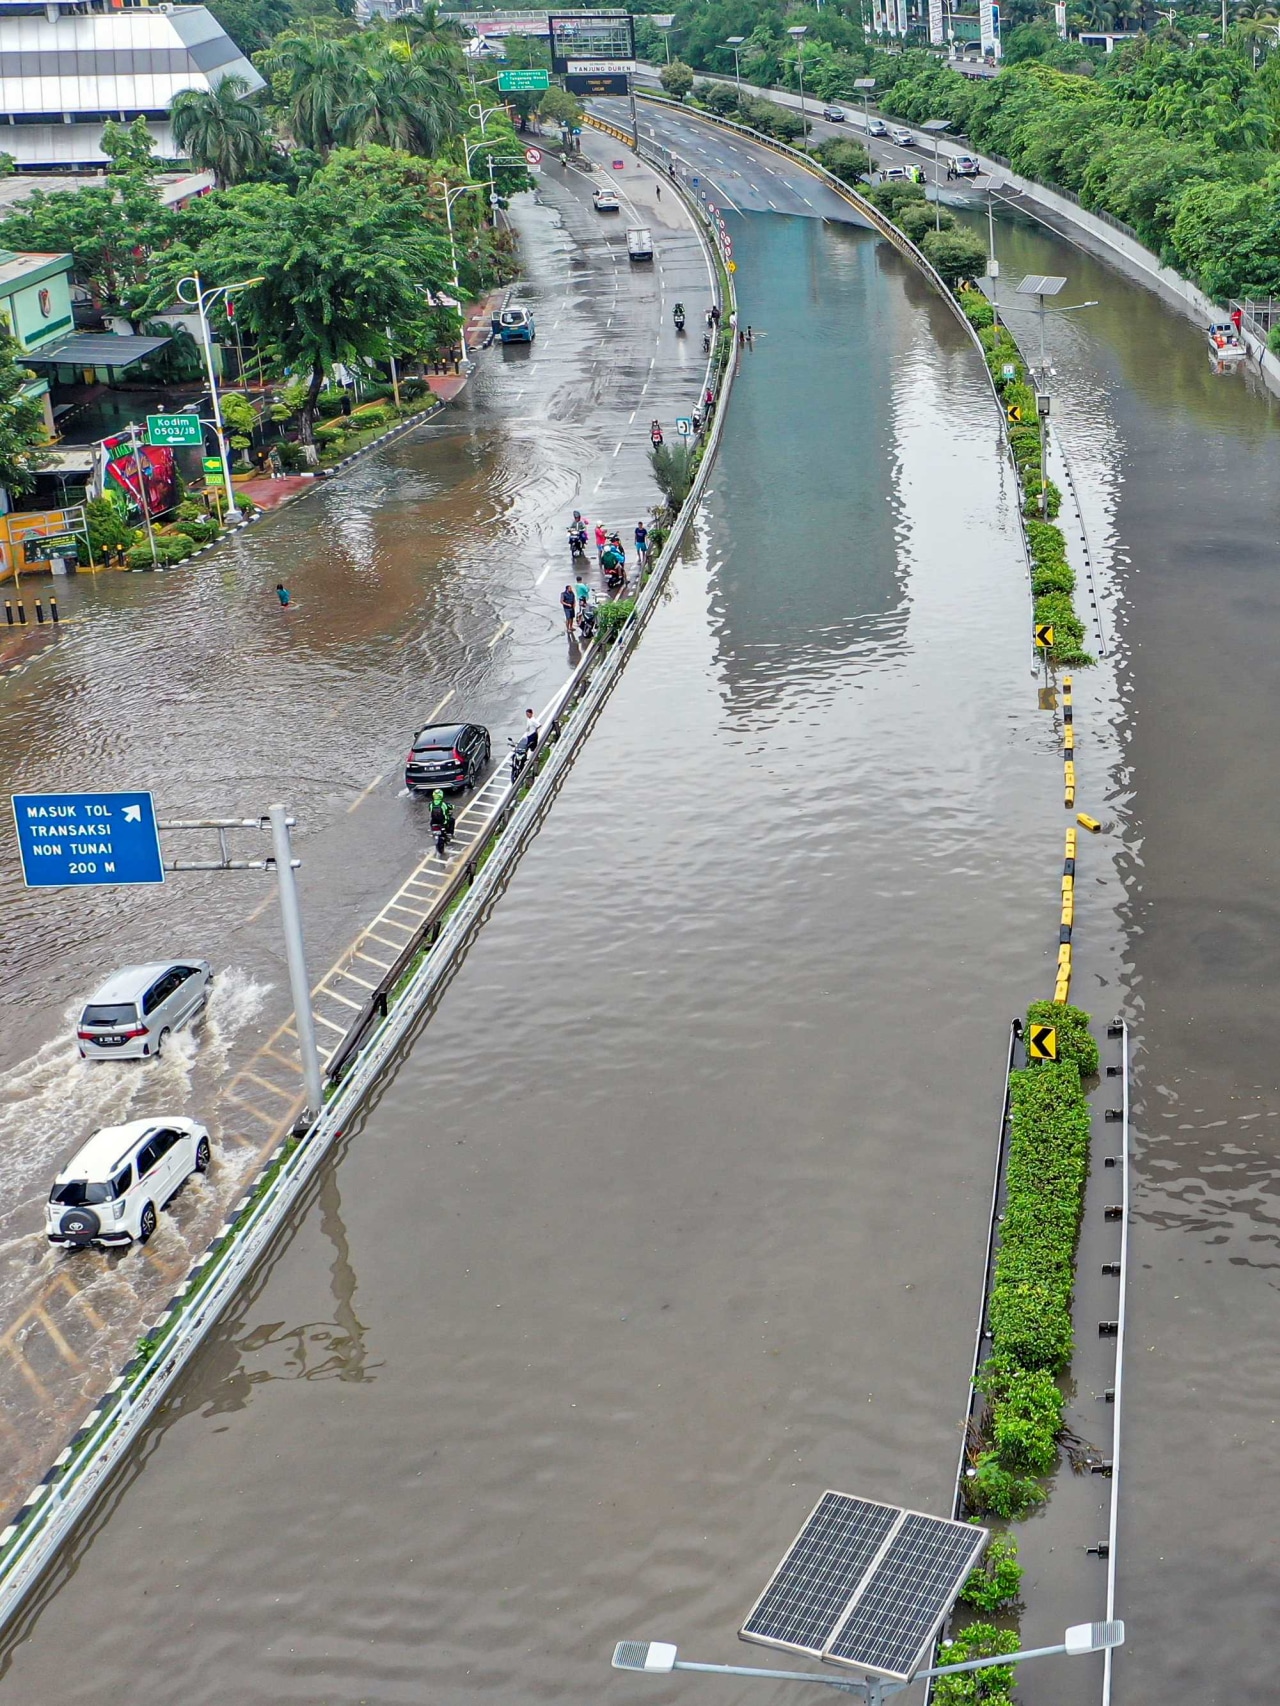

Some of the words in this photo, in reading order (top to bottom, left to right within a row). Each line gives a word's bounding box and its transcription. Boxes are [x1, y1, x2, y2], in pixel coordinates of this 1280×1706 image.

[157, 417, 189, 426] Kodim
[154, 427, 195, 436] 0503/JB
[27, 805, 77, 818] MASUK
[84, 804, 112, 817] TOL
[30, 824, 111, 837] TRANSAKSI
[33, 844, 62, 856] NON
[69, 843, 112, 855] TUNAI
[68, 862, 97, 874] 200
[105, 862, 116, 873] M
